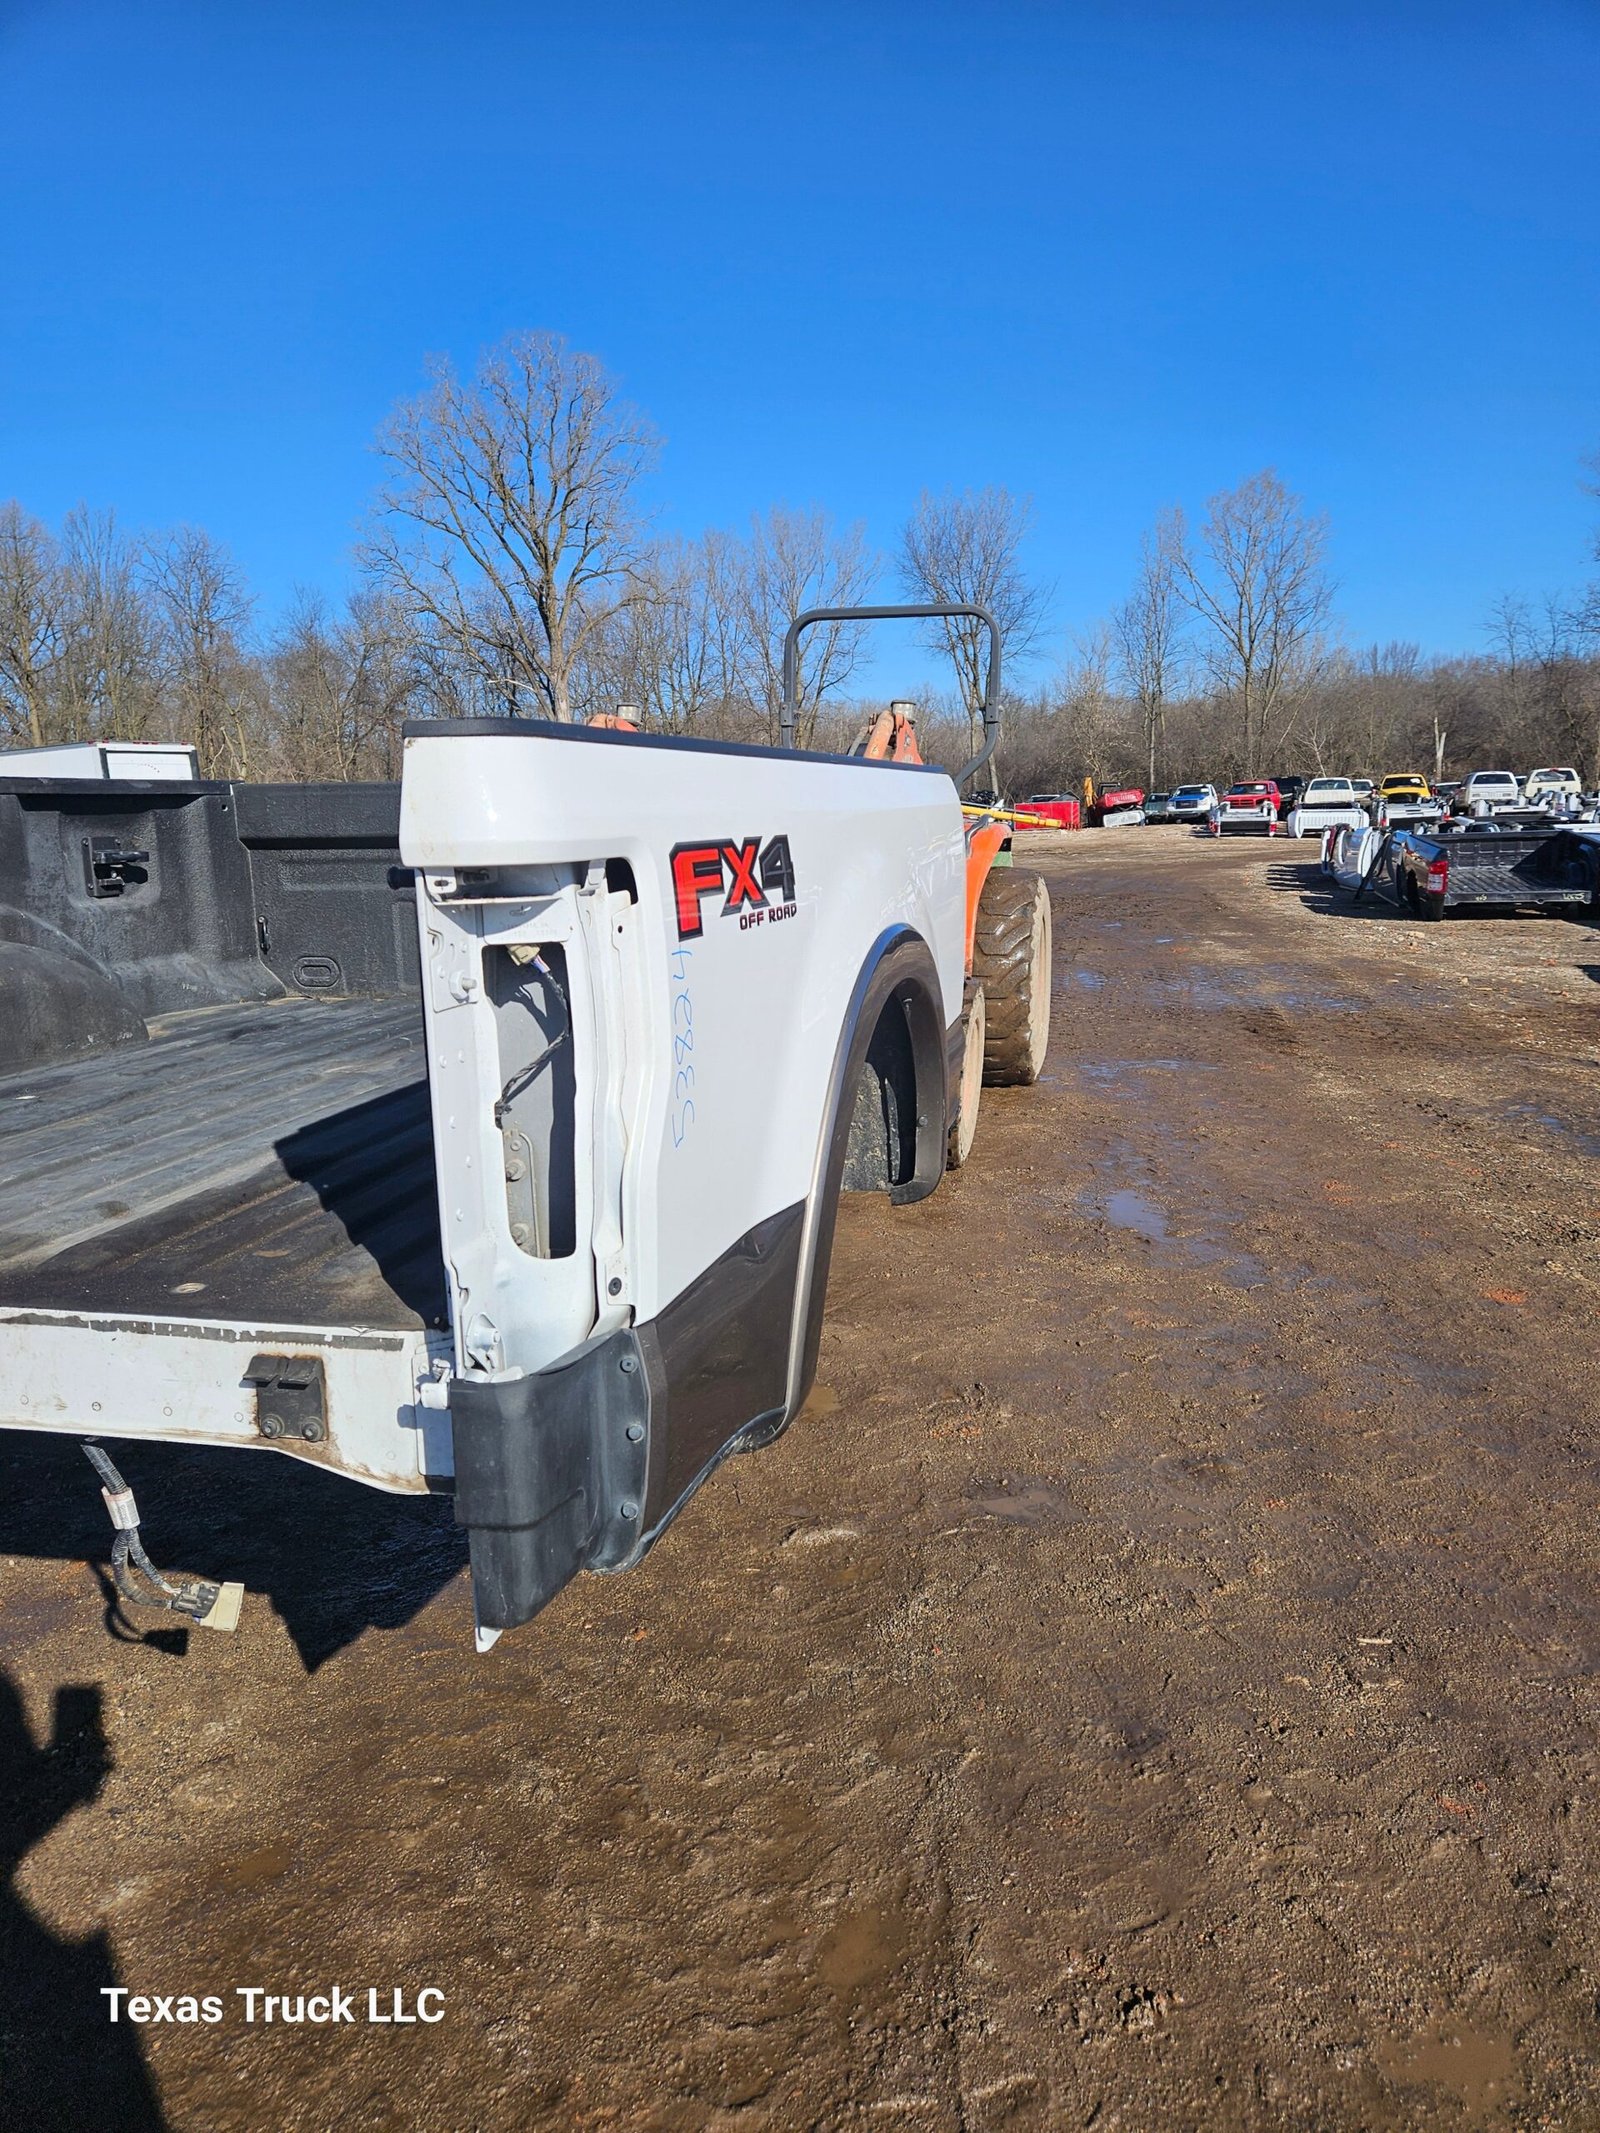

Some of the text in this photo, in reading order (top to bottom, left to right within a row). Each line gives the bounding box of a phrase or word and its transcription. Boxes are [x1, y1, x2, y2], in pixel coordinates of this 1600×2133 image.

[669, 834, 796, 942] FX4
[739, 902, 797, 931] OFF ROAD
[671, 944, 695, 1149] 53824
